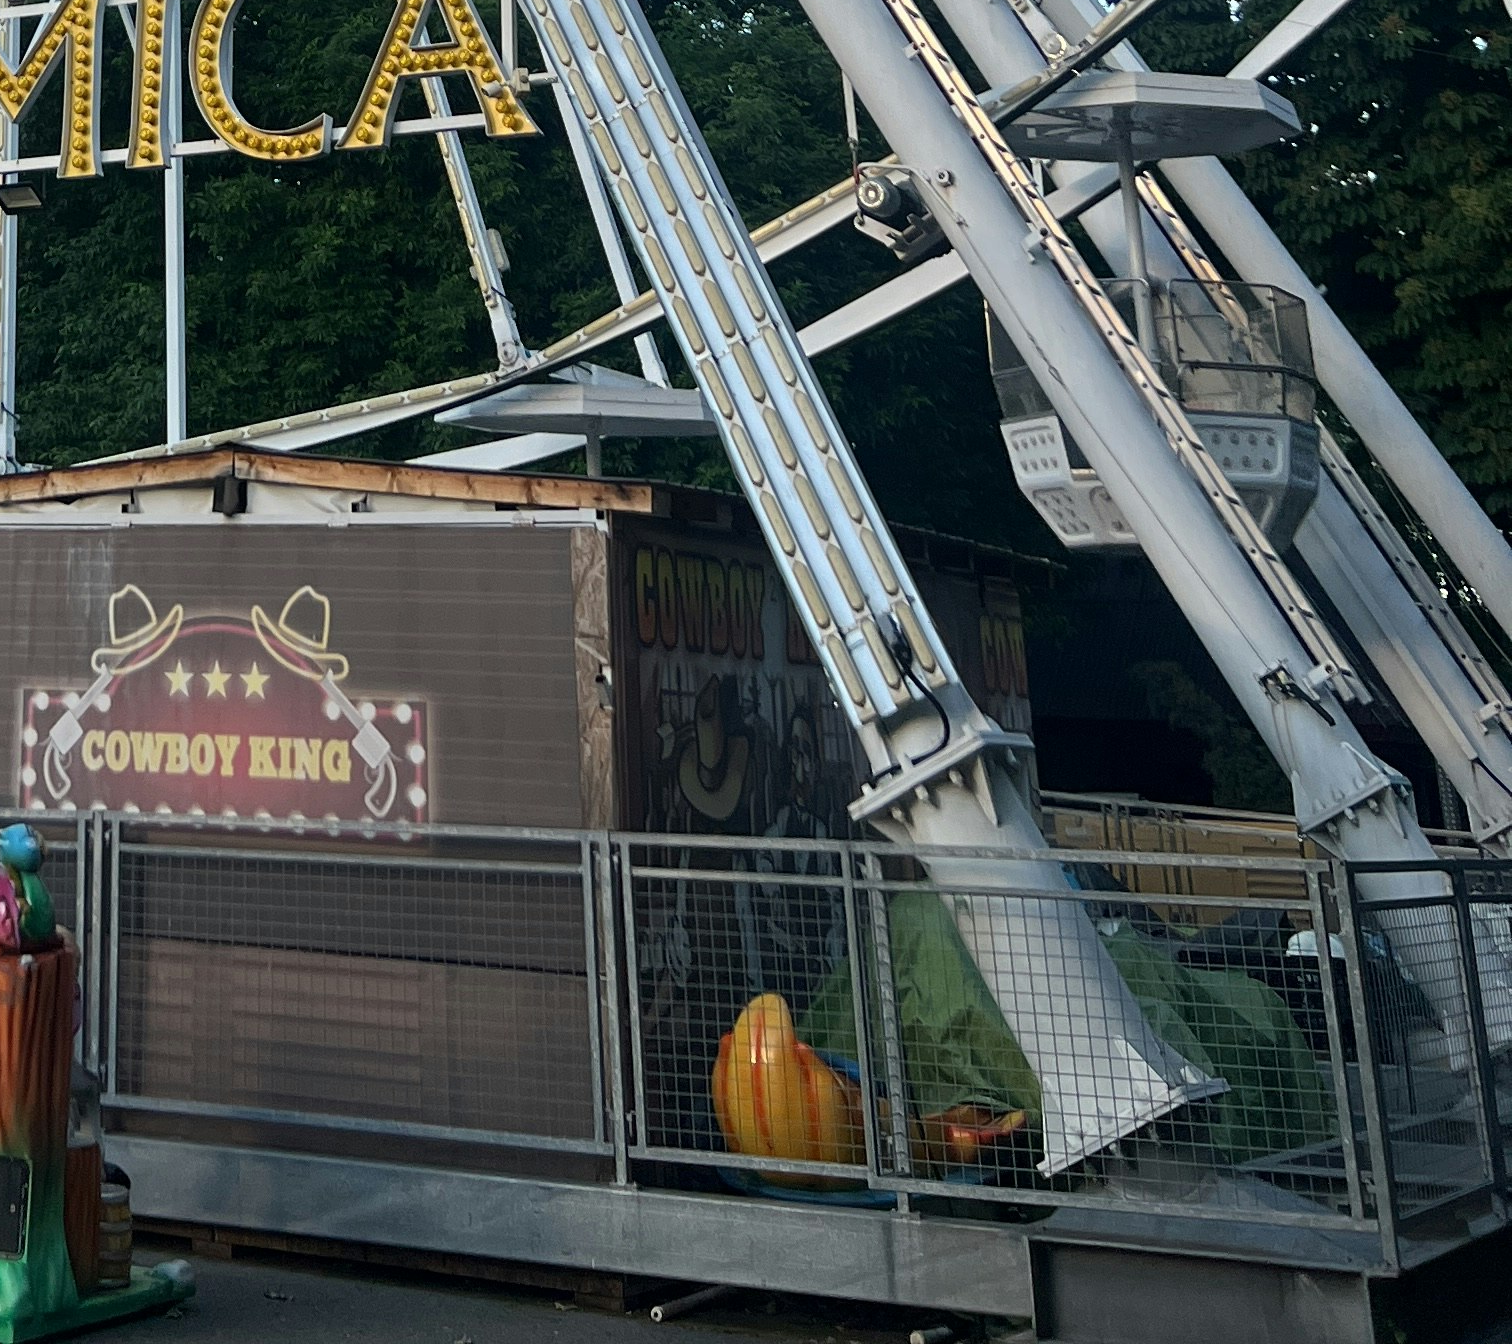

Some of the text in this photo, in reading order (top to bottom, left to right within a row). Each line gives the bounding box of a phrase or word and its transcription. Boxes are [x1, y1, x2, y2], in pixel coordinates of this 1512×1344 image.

[635, 543, 766, 660] COWBOY
[83, 730, 352, 782] COWBOY KING
